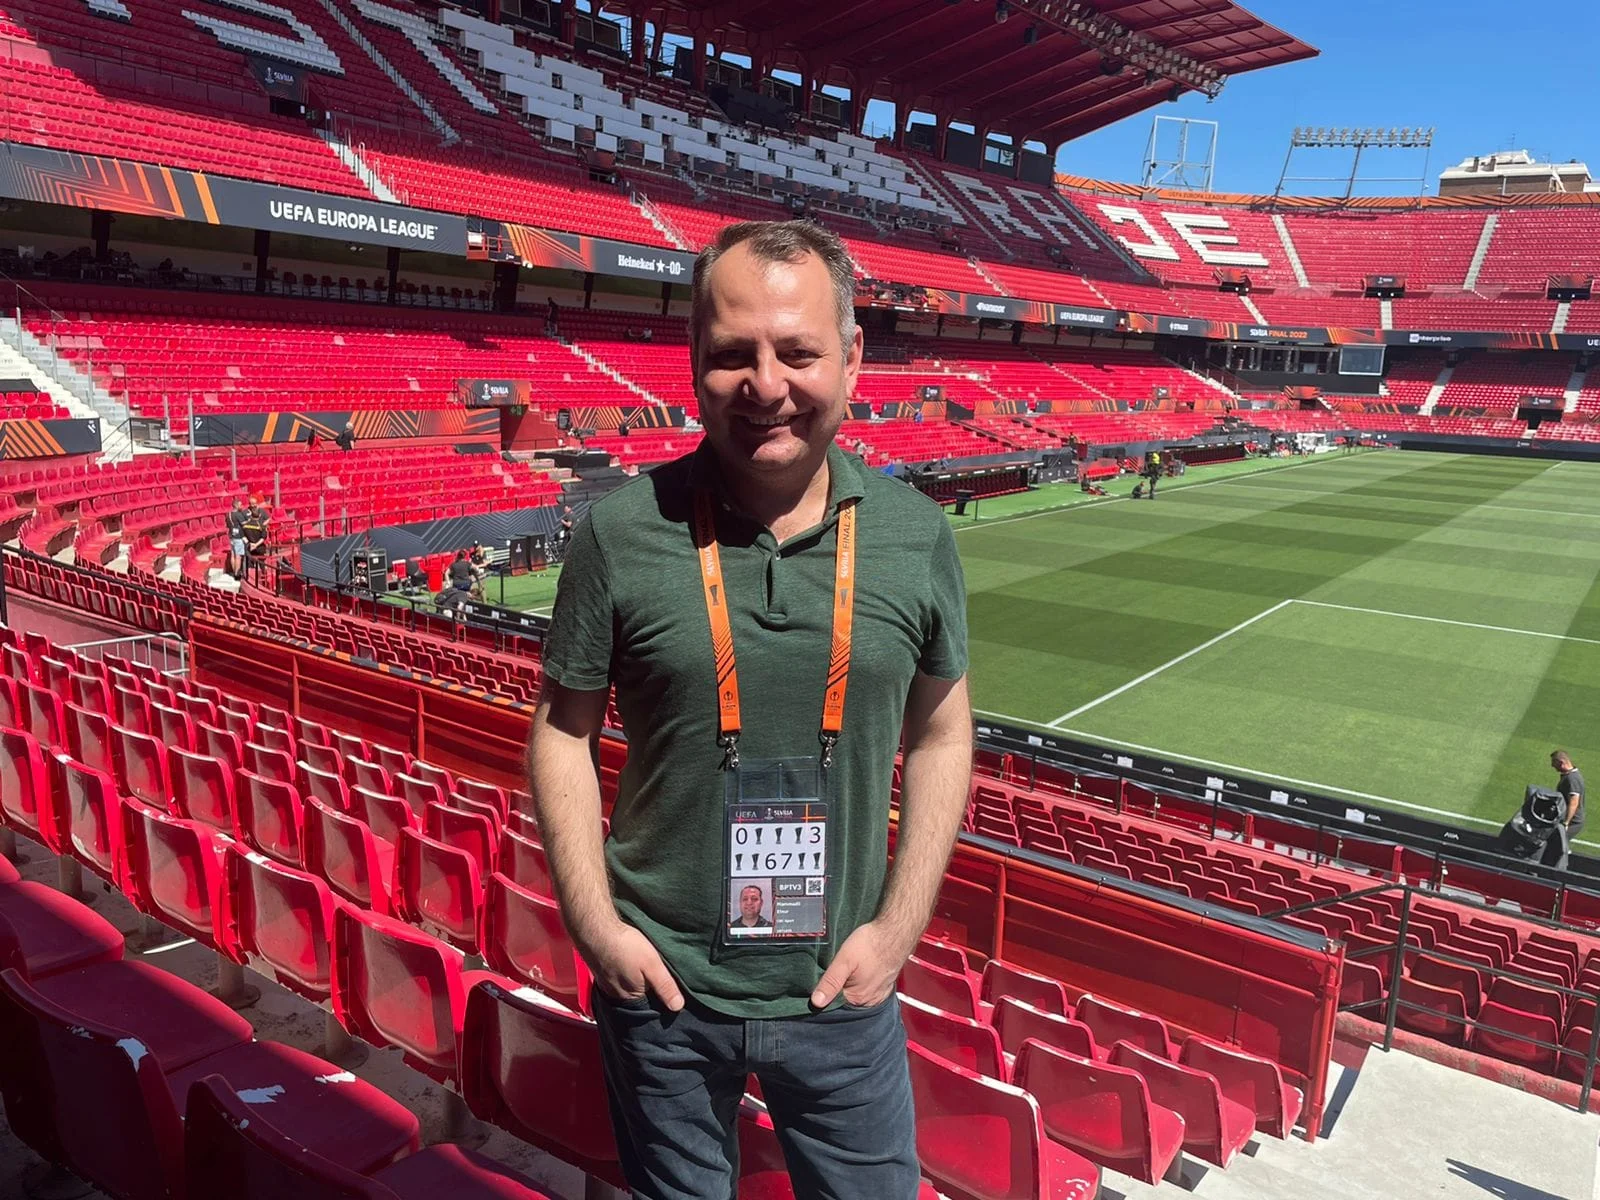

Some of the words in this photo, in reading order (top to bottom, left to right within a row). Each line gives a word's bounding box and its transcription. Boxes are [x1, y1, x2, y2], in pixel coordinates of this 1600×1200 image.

[269, 200, 315, 224] UEFA
[317, 207, 378, 232] EUROPA
[380, 217, 435, 241] LEAGUE
[617, 254, 656, 271] Heineken
[1268, 330, 1288, 338] FINAL
[1289, 331, 1308, 339] 2022
[1587, 338, 1600, 346] UE
[842, 522, 851, 550] FINAL
[735, 810, 758, 818] UEFA
[809, 826, 821, 844] 3
